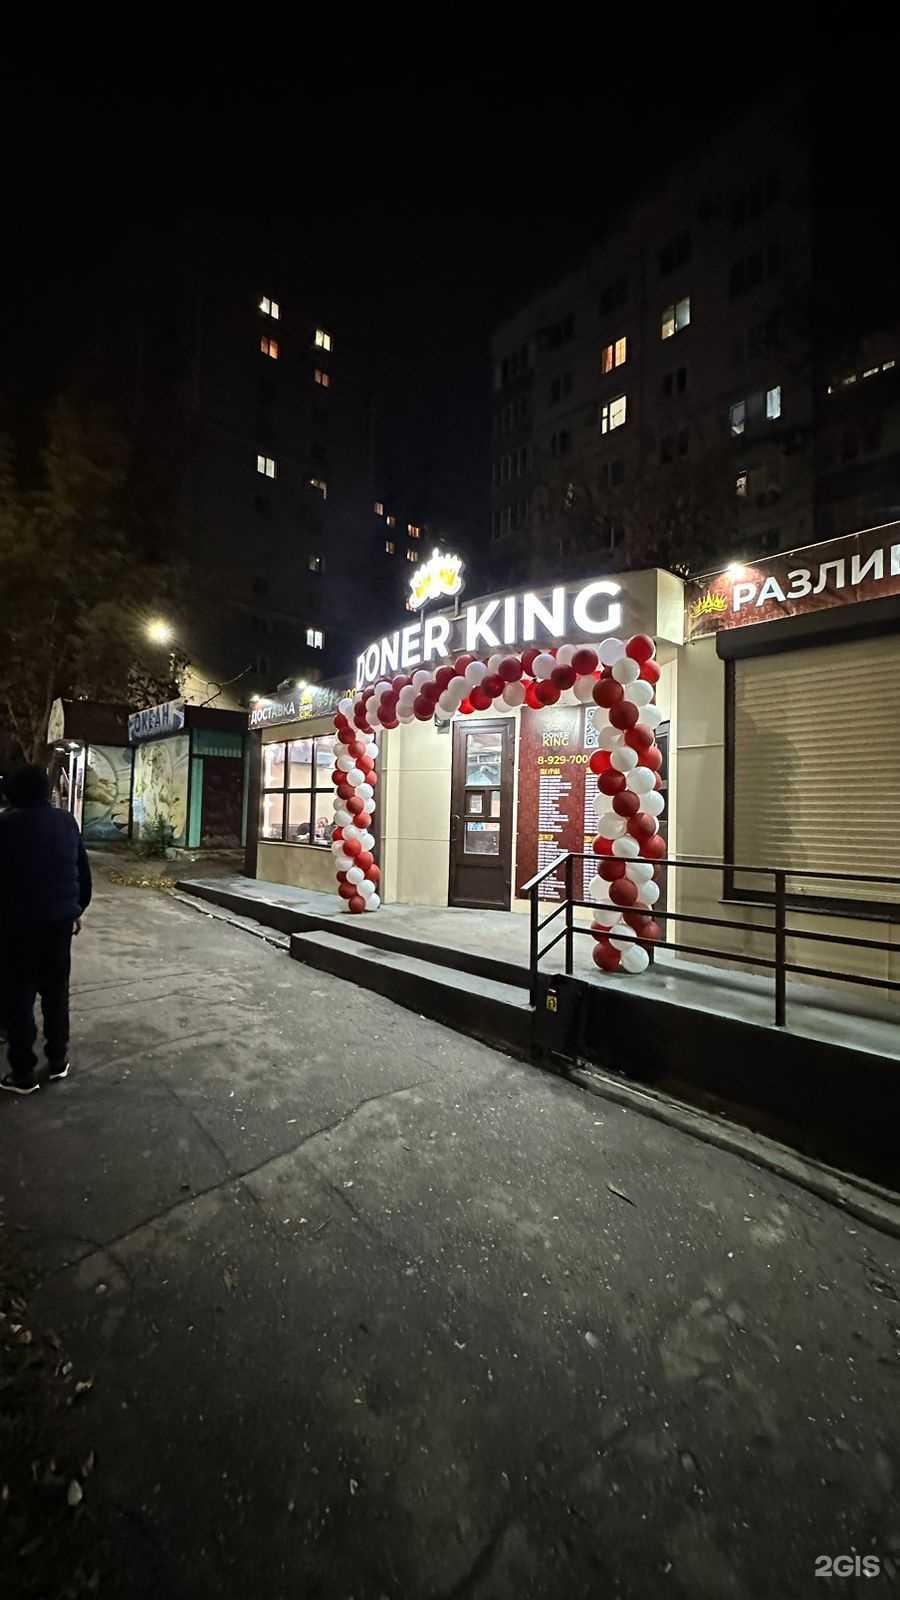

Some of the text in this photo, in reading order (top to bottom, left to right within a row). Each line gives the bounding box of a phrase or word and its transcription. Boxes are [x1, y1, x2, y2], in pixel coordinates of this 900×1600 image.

[356, 580, 621, 688] DONER KING
[250, 702, 295, 725] ДОСТАВКА
[543, 736, 569, 747] KING
[537, 754, 590, 765] 8-929-700
